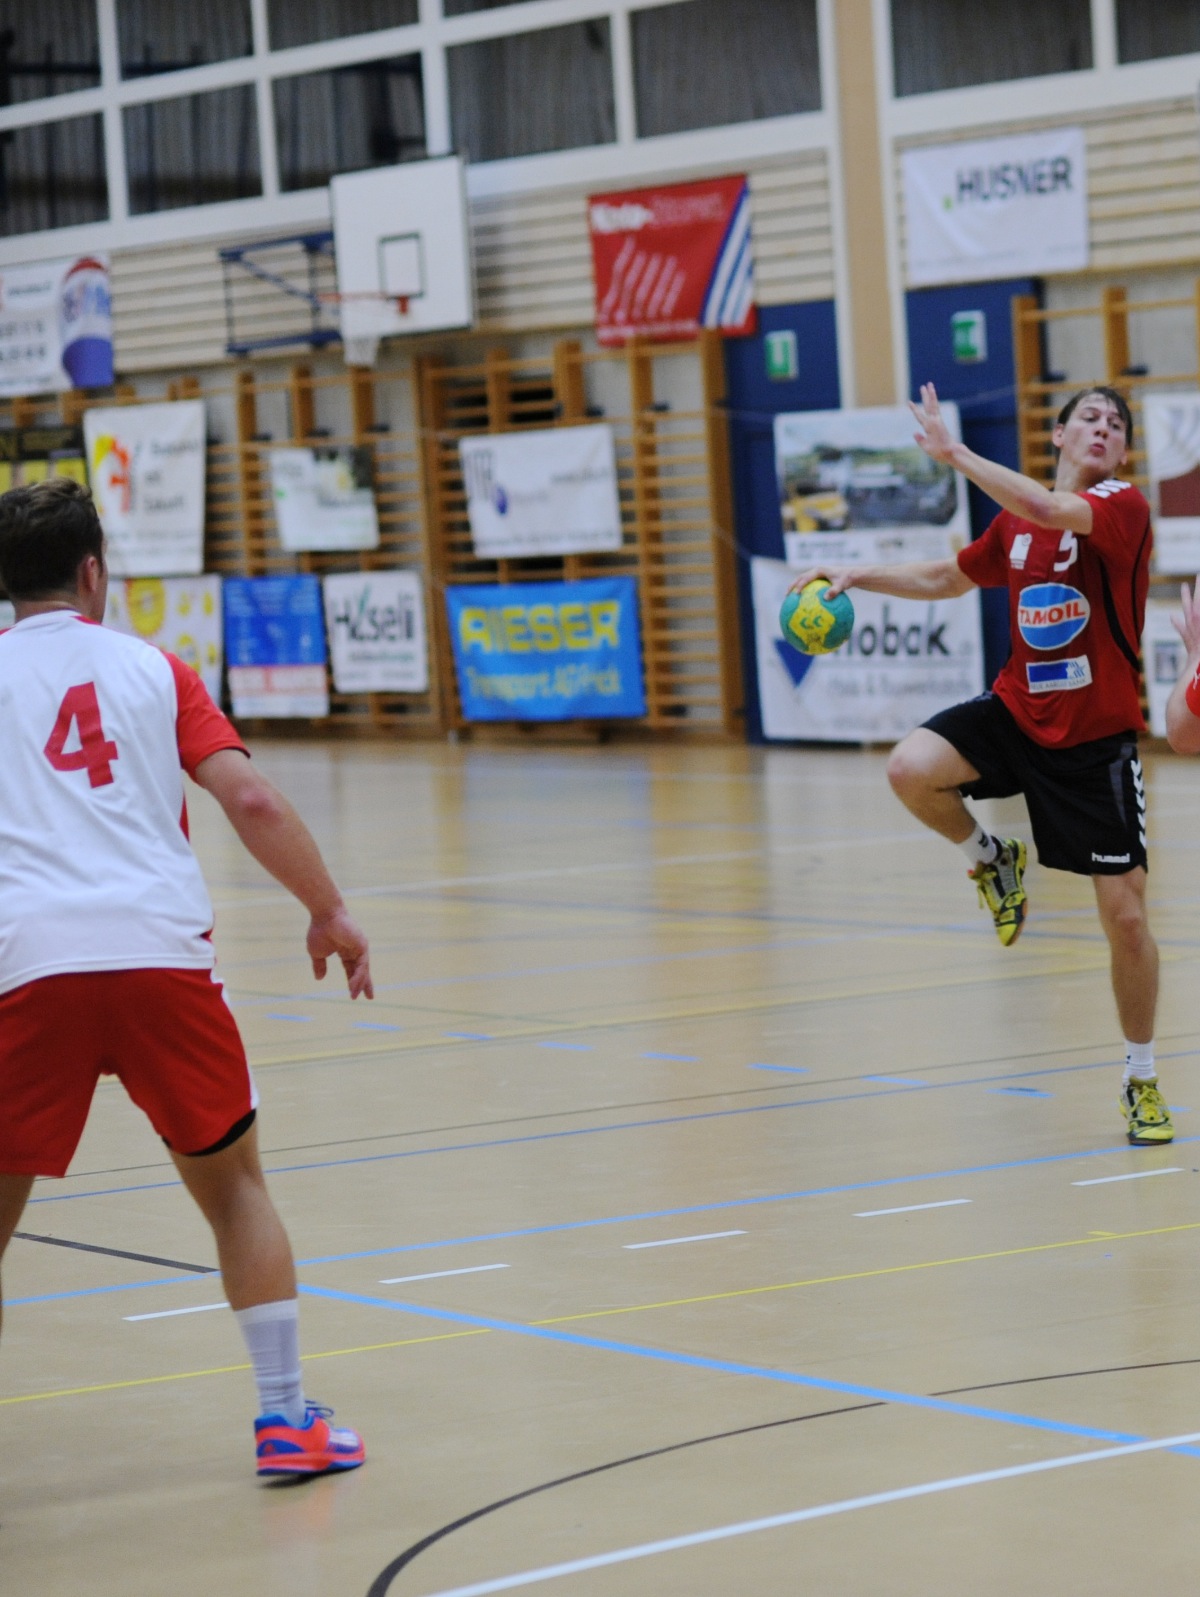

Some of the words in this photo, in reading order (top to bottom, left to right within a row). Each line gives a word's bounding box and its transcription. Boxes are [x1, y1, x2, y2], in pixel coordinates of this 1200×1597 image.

[956, 155, 1073, 204] HUSNER
[459, 601, 621, 653] RIESER
[1020, 601, 1086, 626] TAMOIL
[43, 681, 119, 789] 4
[1091, 851, 1130, 864] hummel
